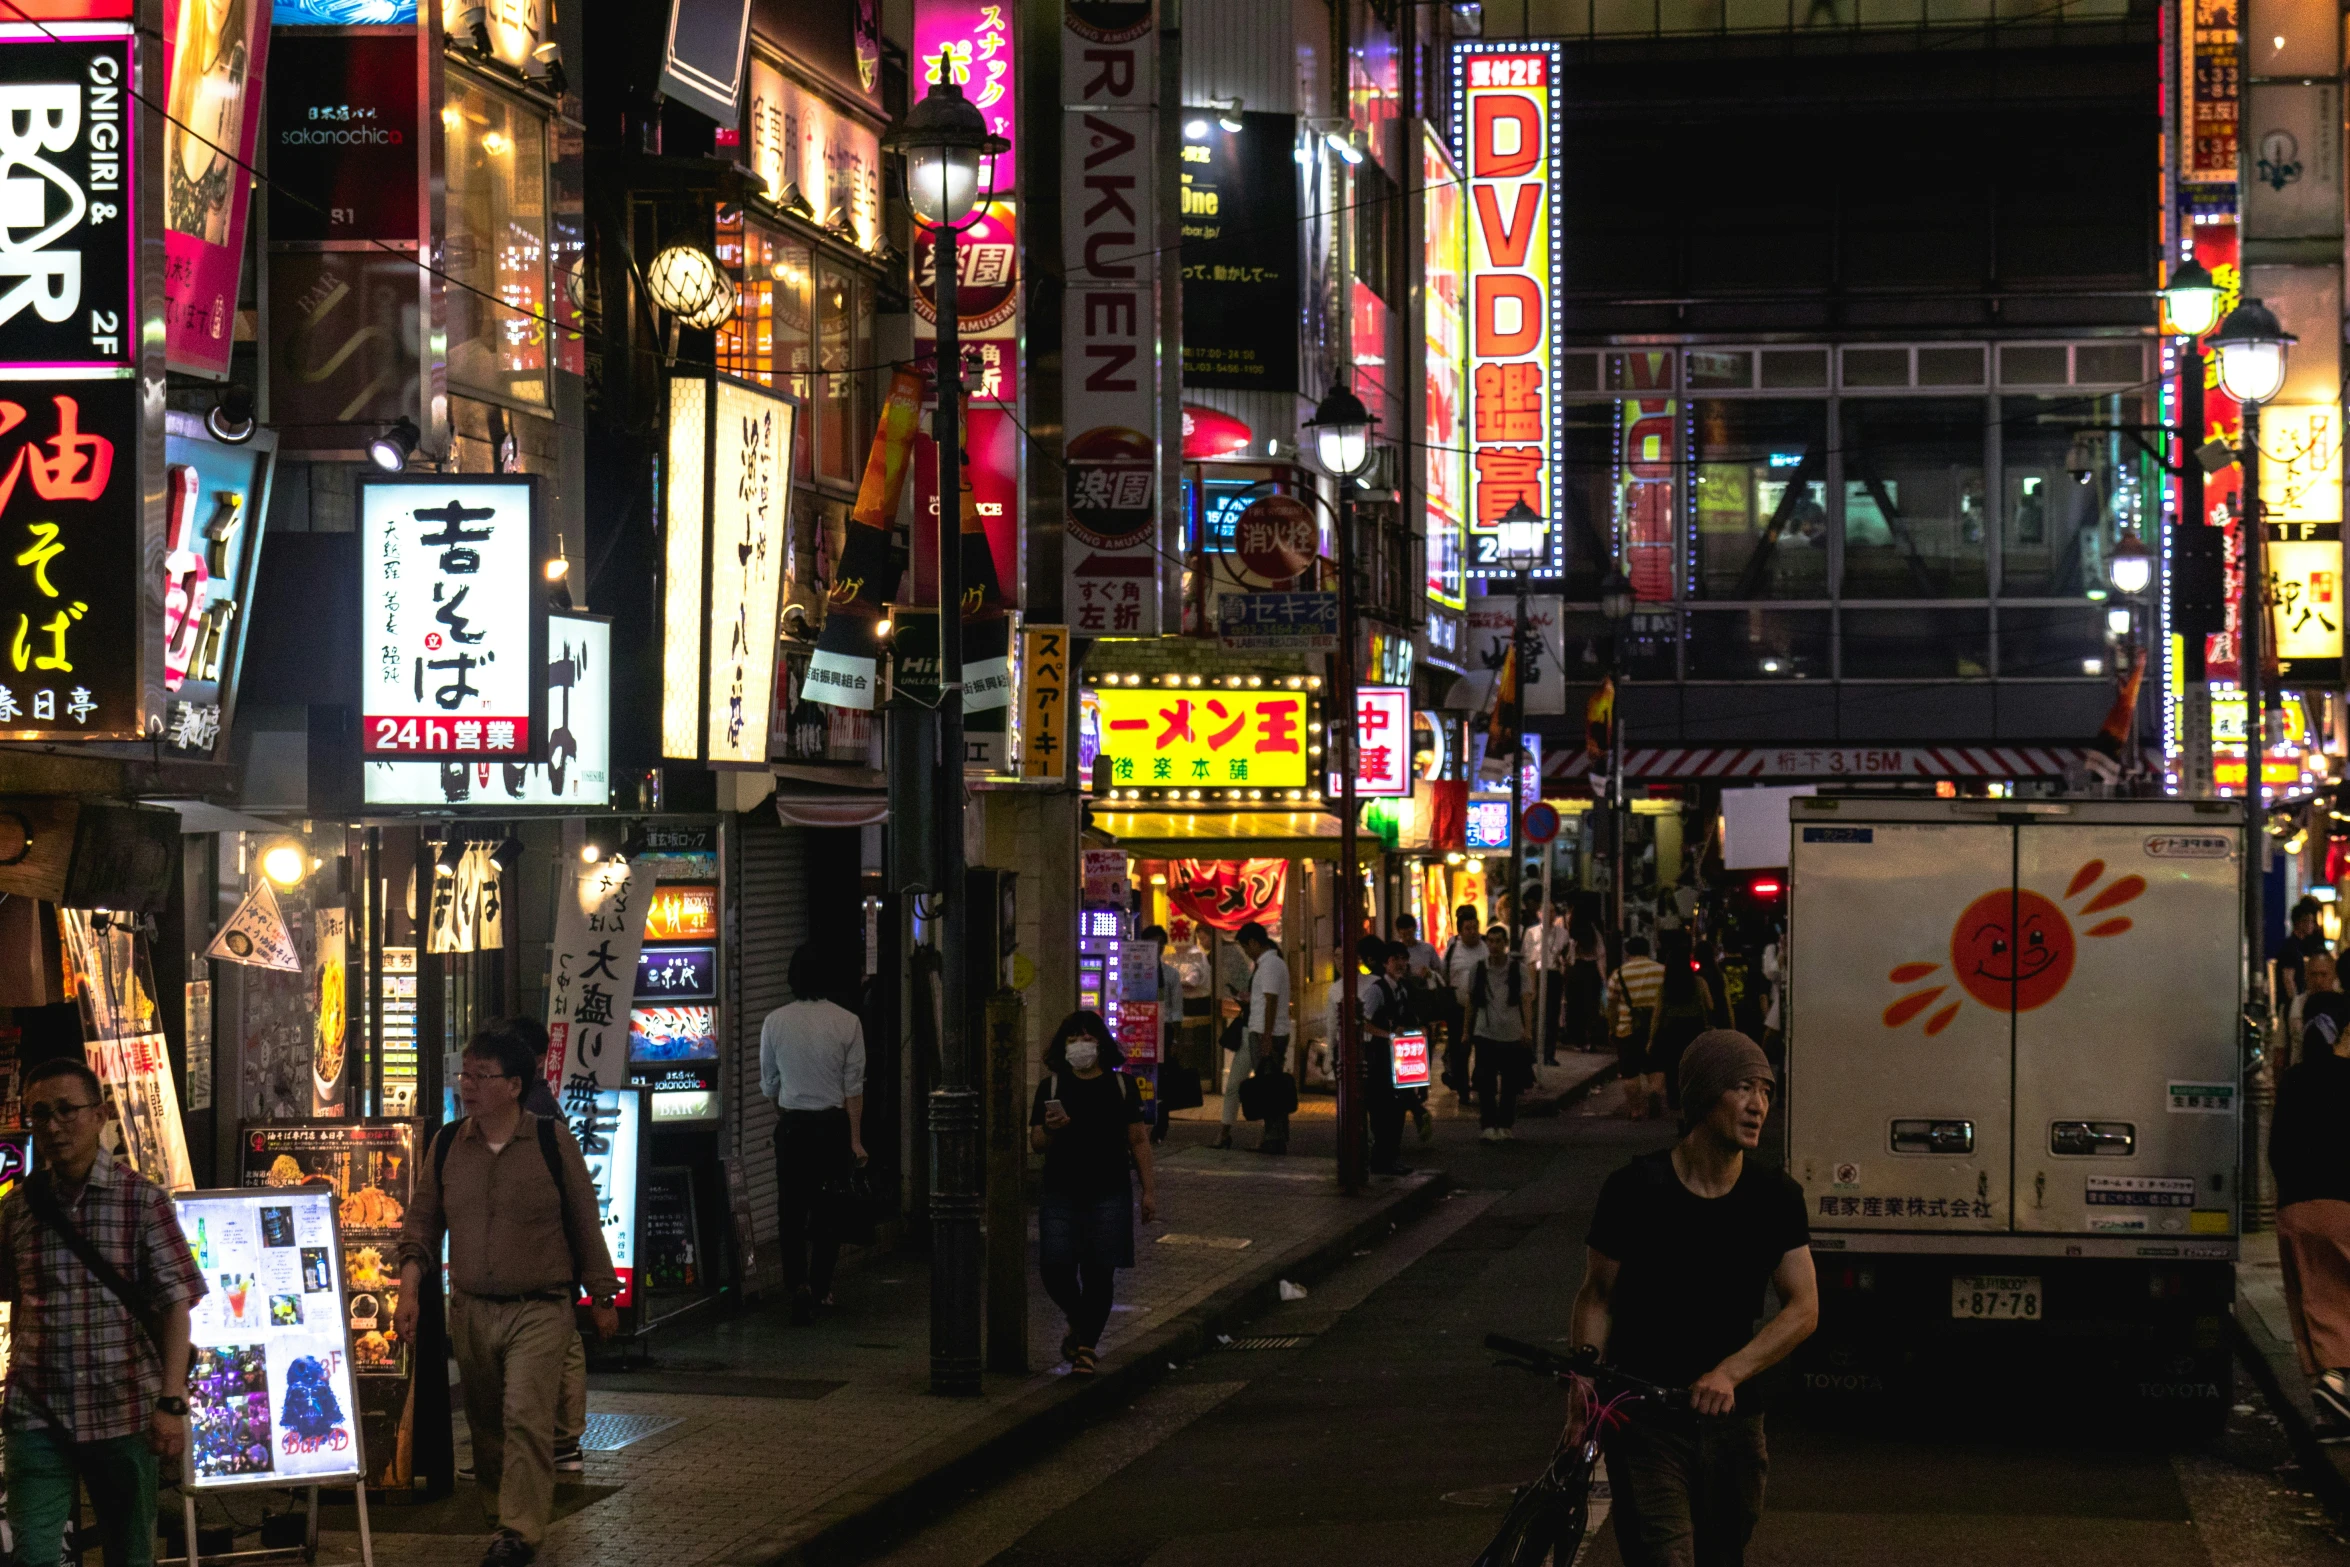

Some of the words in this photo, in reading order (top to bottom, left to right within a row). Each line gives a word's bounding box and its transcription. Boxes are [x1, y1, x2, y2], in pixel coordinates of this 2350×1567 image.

[1471, 57, 1542, 87] 受付2F
[90, 55, 119, 191] ONIGIRI
[282, 125, 403, 145] sakanochica
[90, 202, 118, 225] &
[1083, 50, 1137, 393] RAKUEN
[90, 310, 119, 355] 2F
[1072, 467, 1150, 510] 楽園
[1243, 521, 1313, 554] 消火栓
[2278, 523, 2316, 541] 1F
[1078, 580, 1141, 600] すぐ角
[410, 500, 498, 711] 吉そば
[1078, 604, 1141, 631] 左折
[426, 633, 443, 649] 立
[1034, 633, 1063, 777] スペアーキー
[376, 718, 515, 750] 24h営業
[1356, 701, 1392, 783] 中華
[1114, 757, 1249, 781] 後楽本舗
[1829, 751, 1904, 774] 3.15M
[684, 897, 715, 907] ROYAL
[691, 914, 708, 928] 4F
[660, 1101, 694, 1117] BAR
[1819, 1196, 1993, 1219] 尾家産業株式会社
[1971, 1292, 2037, 1316] 87-78
[318, 1351, 342, 1381] 3F
[1803, 1373, 1884, 1392] TOYOTA
[2138, 1382, 2220, 1399] TOYOTA
[281, 1432, 320, 1456] Bar
[328, 1429, 349, 1452] D
